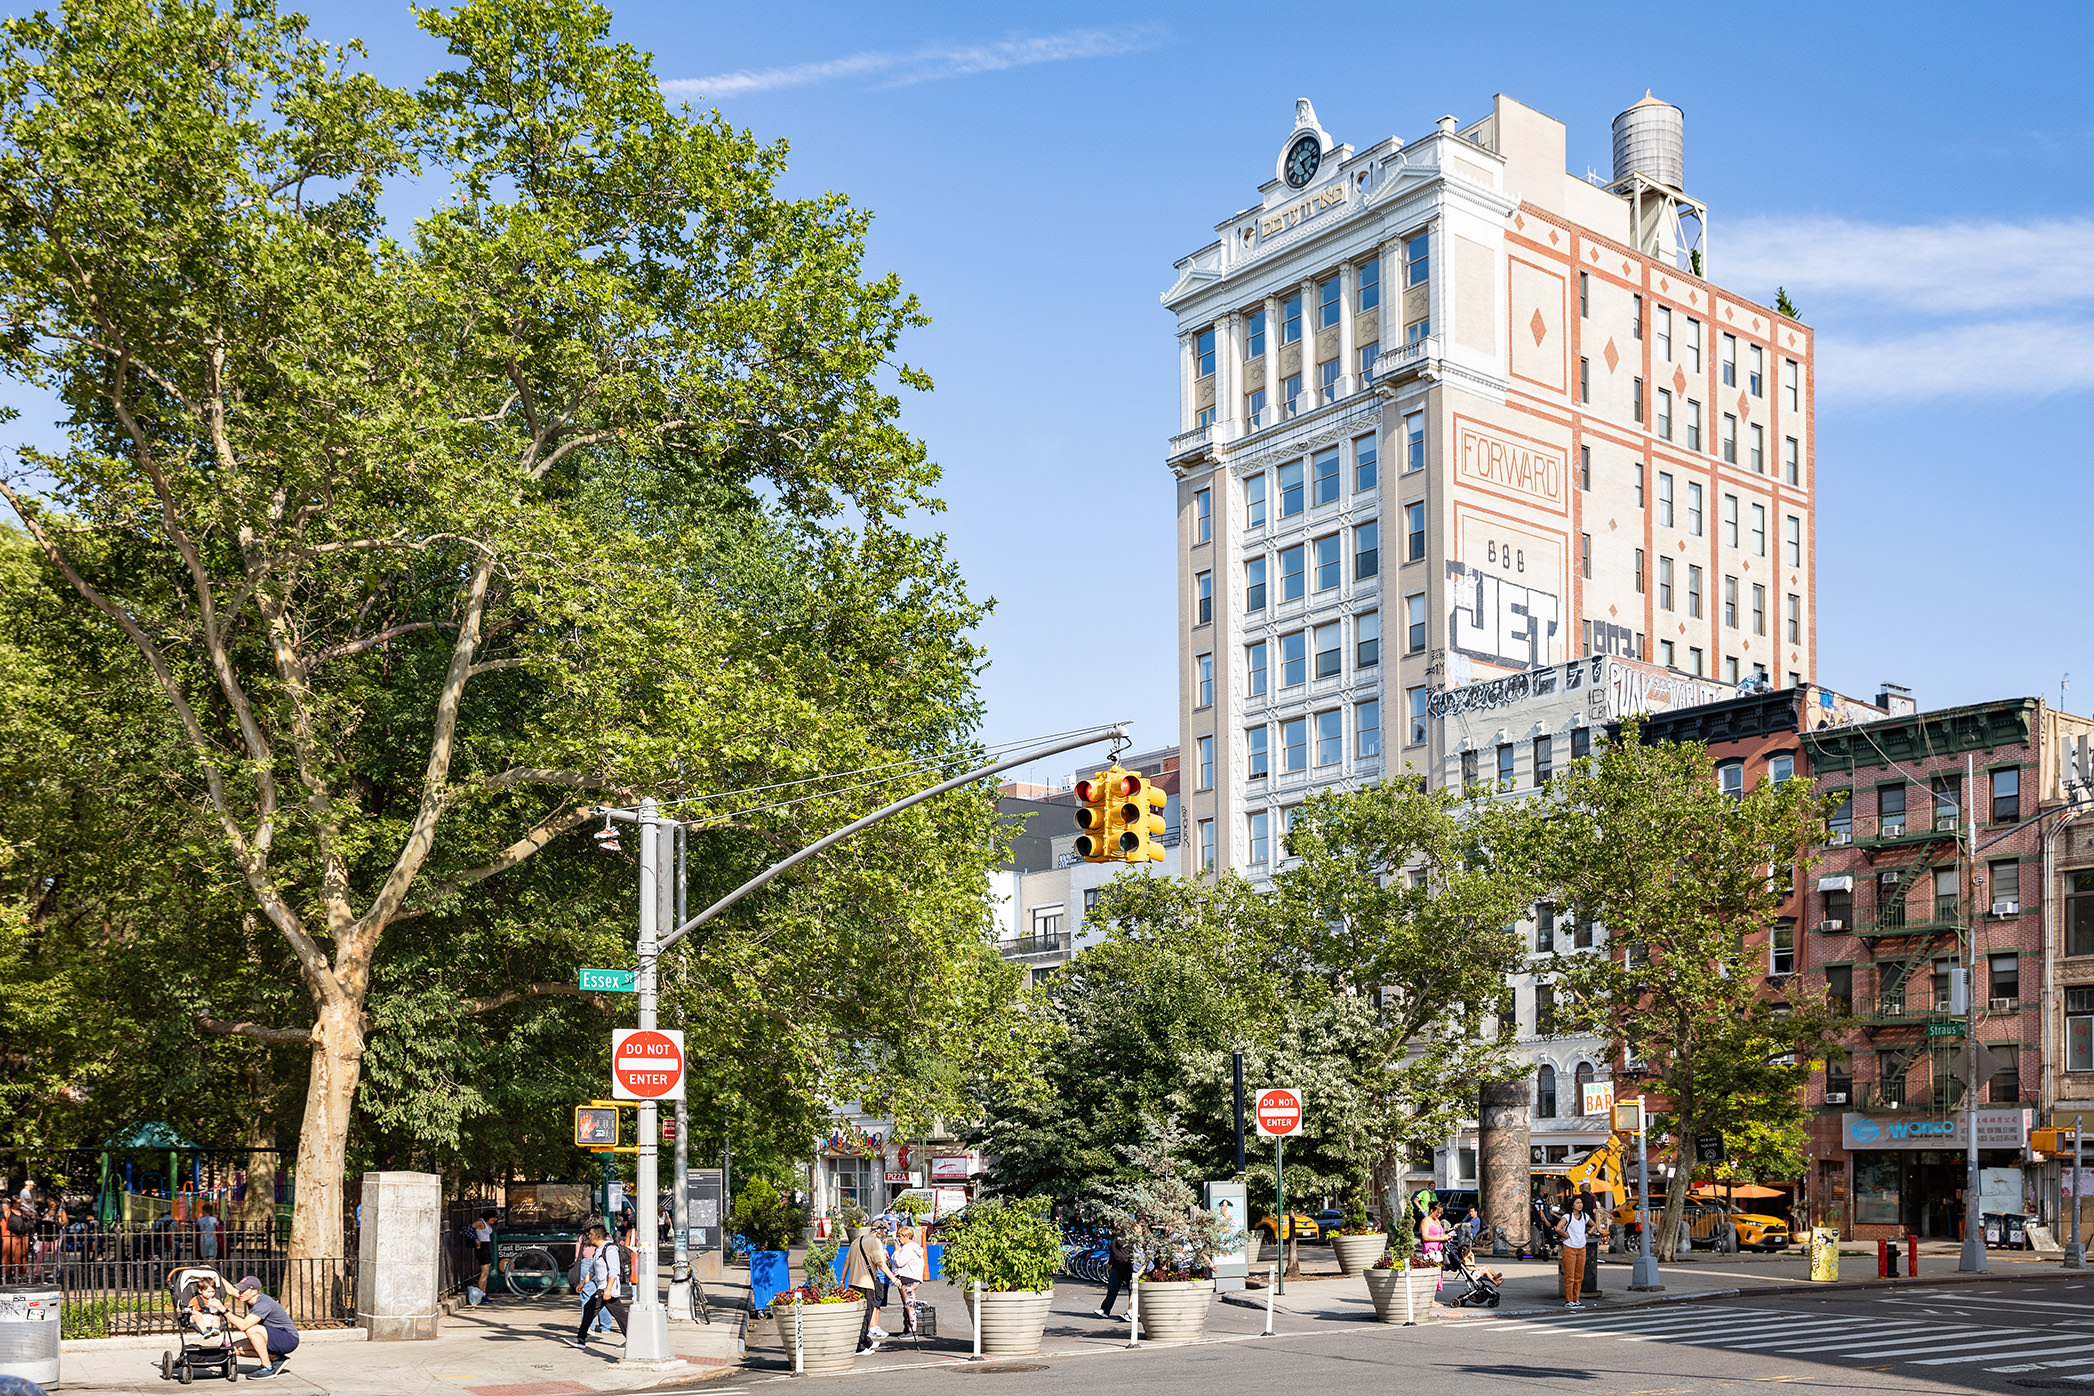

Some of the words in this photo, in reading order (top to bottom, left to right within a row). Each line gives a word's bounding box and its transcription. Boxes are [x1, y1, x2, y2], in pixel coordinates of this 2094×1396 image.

[1464, 432, 1559, 498] FORWARD
[1446, 560, 1558, 672] JET
[583, 971, 619, 989] Essex
[1929, 1024, 1956, 1036] Straus
[626, 1043, 643, 1055] DO
[647, 1044, 670, 1055] NOT
[629, 1074, 668, 1085] ENTER
[1586, 1084, 1602, 1095] 169
[1263, 1098, 1275, 1107] DO
[1278, 1098, 1294, 1107] NOT
[1586, 1094, 1612, 1112] BAR
[1266, 1118, 1292, 1127] ENTER
[887, 1172, 907, 1180] PIZZA
